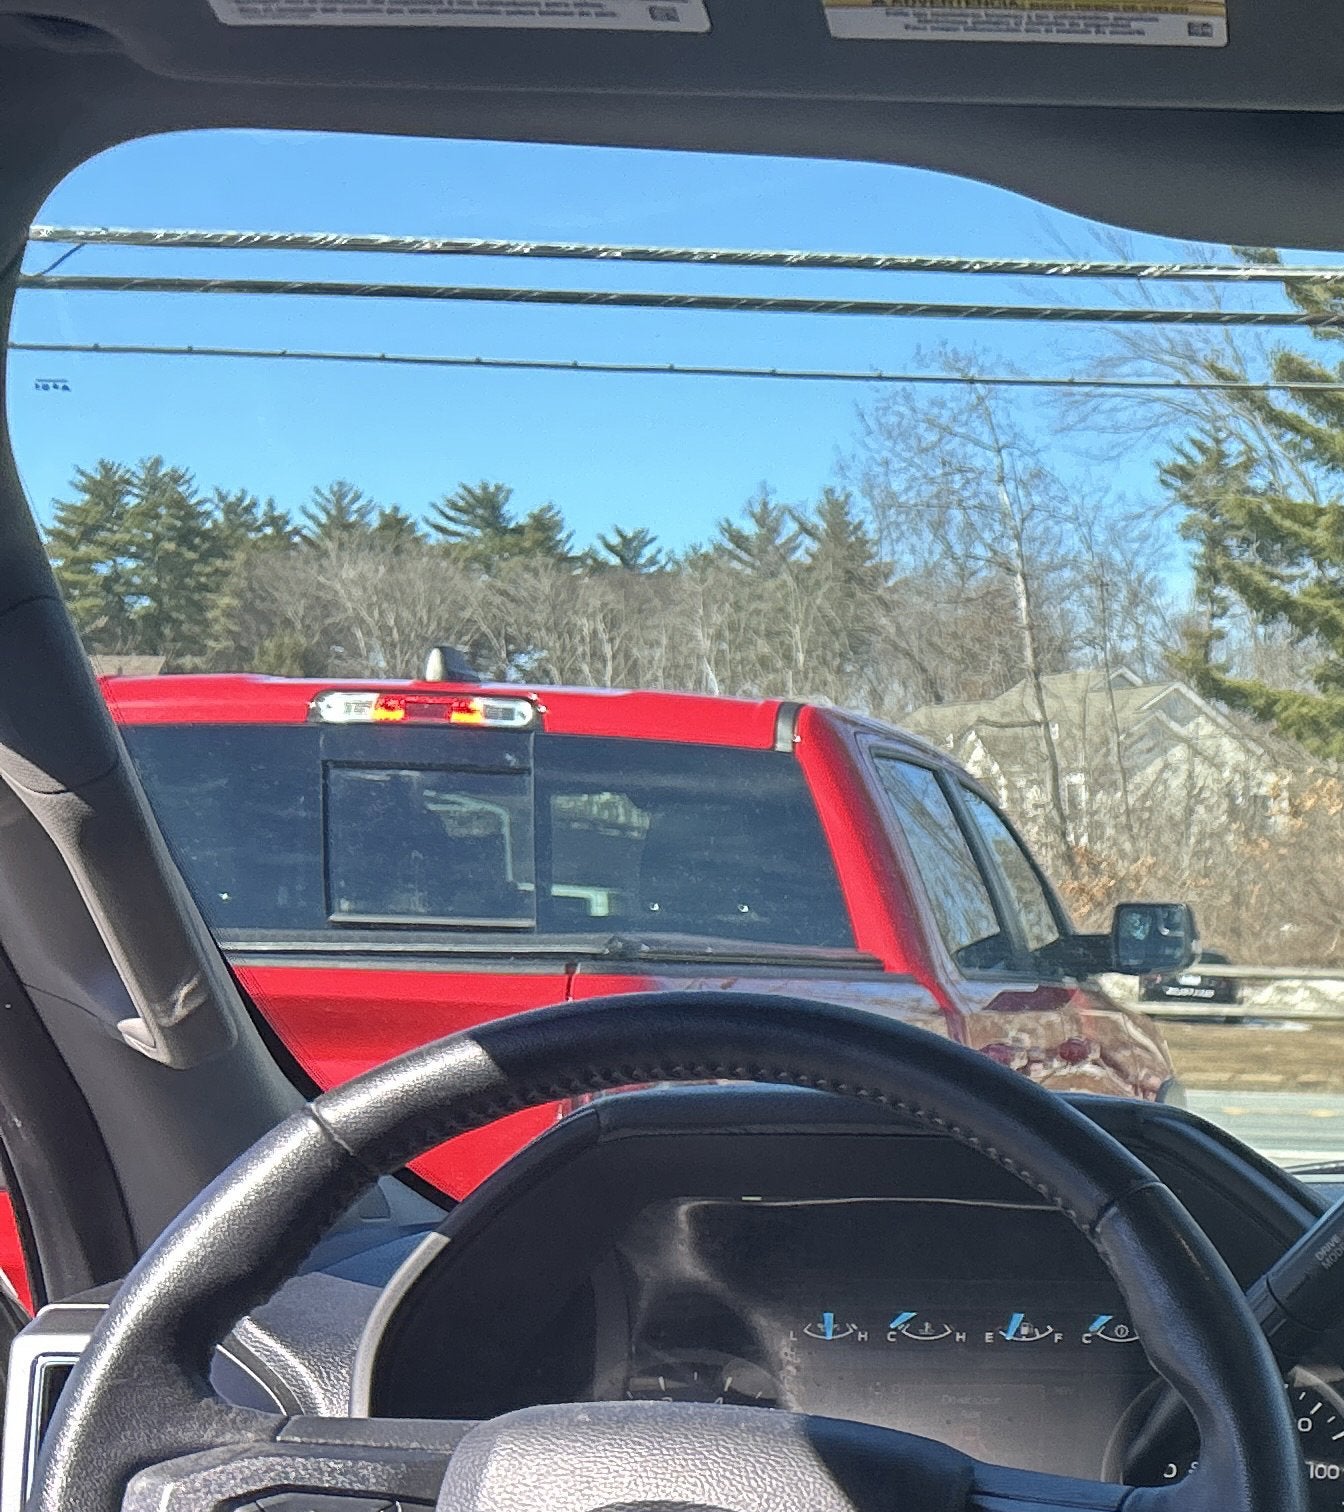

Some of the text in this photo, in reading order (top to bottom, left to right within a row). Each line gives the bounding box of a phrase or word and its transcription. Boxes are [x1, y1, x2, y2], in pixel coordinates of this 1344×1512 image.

[1314, 1234, 1341, 1260] DRIVE
[790, 1332, 797, 1341] L
[858, 1332, 867, 1341] H
[887, 1332, 896, 1341] C
[956, 1332, 966, 1341] H
[985, 1333, 993, 1342] E
[1055, 1333, 1063, 1343] F
[1082, 1333, 1091, 1343] C
[1308, 1462, 1340, 1480] 100
